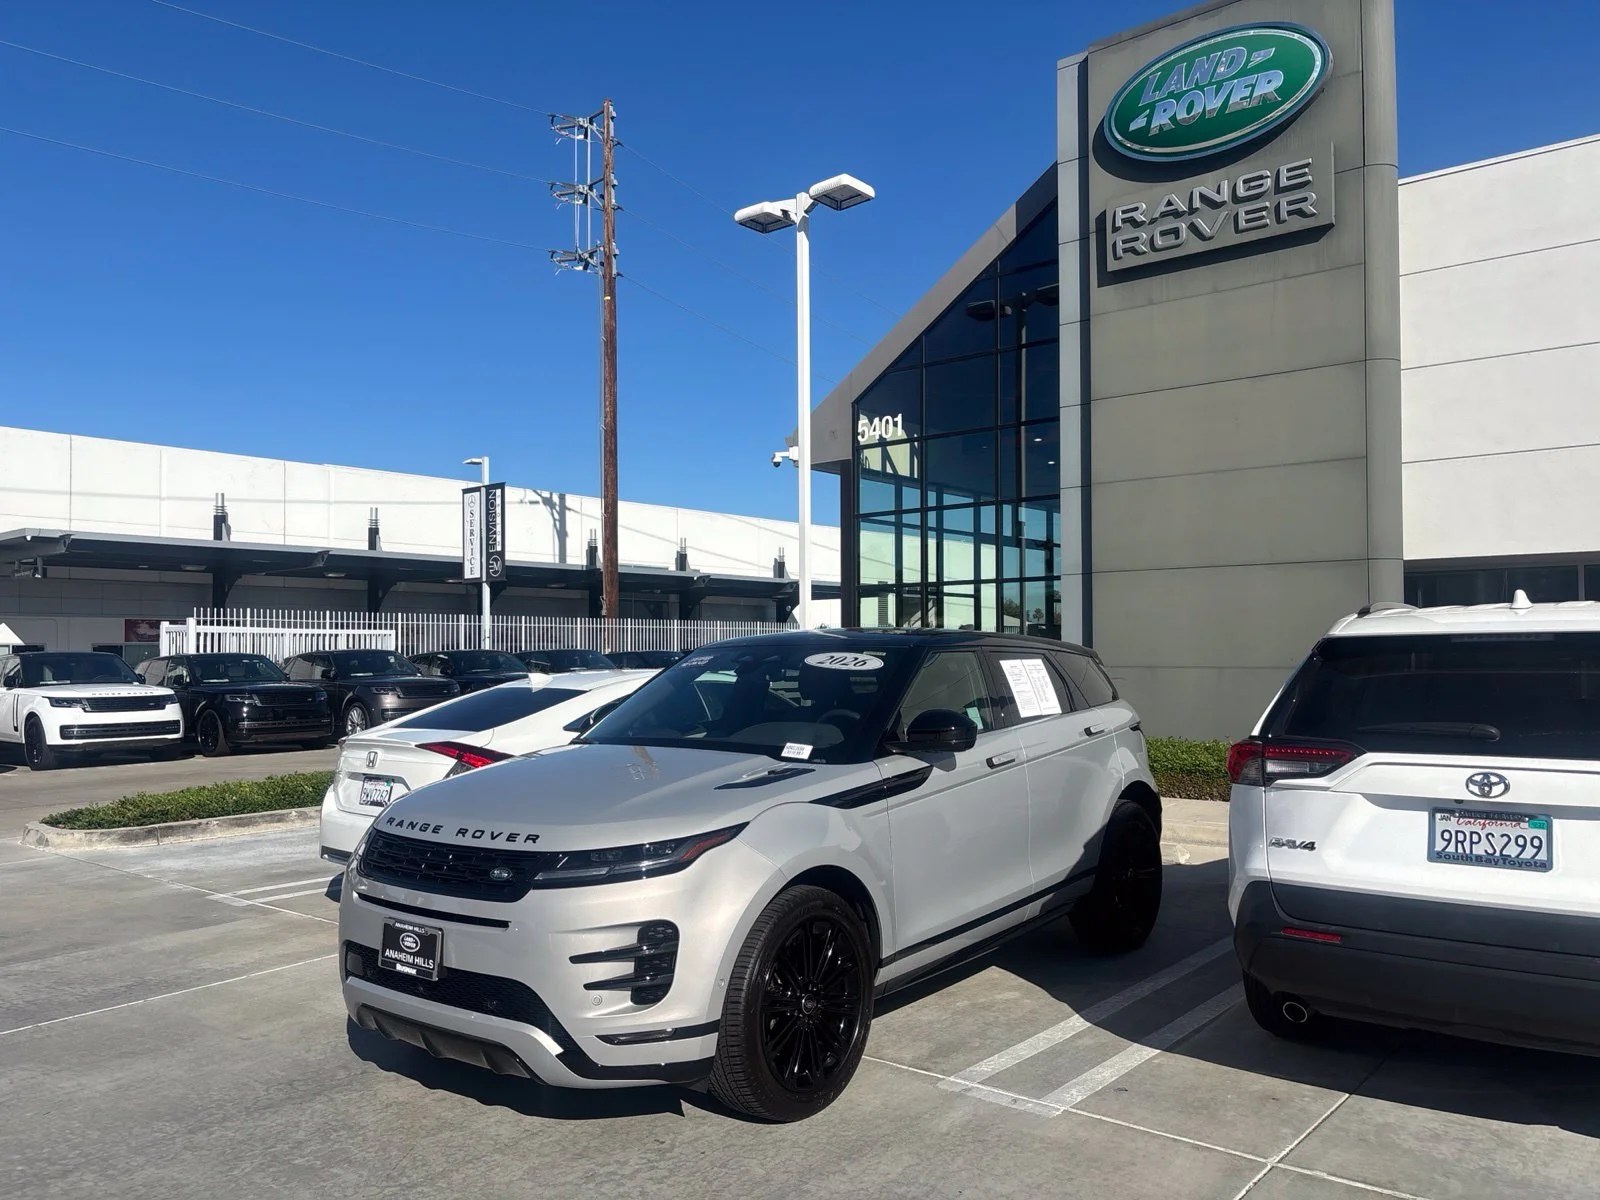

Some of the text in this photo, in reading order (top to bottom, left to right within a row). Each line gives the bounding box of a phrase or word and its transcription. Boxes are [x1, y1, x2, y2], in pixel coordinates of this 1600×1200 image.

[1139, 47, 1247, 106] LAND
[1149, 70, 1284, 136] ROVER
[1115, 158, 1312, 228] RANGE
[1115, 192, 1318, 259] ROVER
[857, 413, 903, 442] 5401
[816, 655, 868, 667] 2026
[386, 817, 541, 844] RANGE ROVER
[1438, 814, 1451, 822] JAN
[1456, 818, 1528, 830] California
[1441, 829, 1543, 859] 9RPS299
[1436, 851, 1548, 869] South Bay Toyota
[384, 948, 413, 963] ANAHEIM
[414, 956, 434, 969] HILLS
